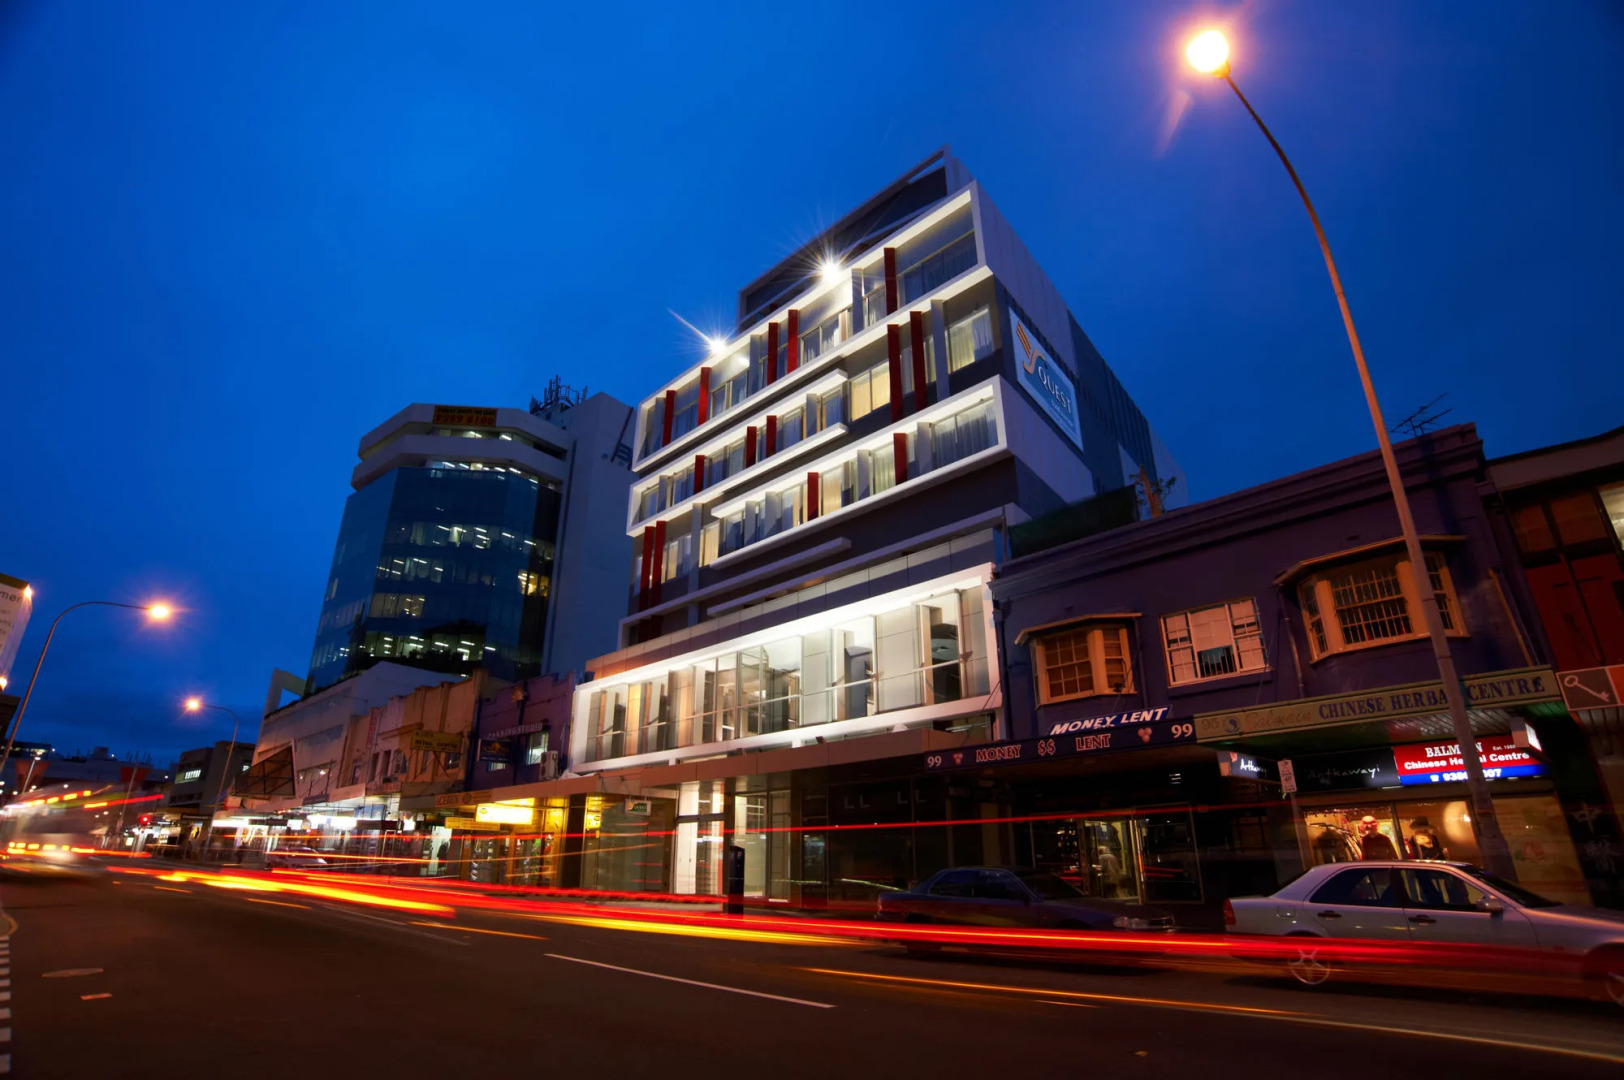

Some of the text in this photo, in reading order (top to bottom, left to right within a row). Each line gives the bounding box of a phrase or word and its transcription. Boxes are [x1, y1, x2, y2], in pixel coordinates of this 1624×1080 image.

[1038, 366, 1071, 414] QUEST
[1318, 696, 1386, 719] CHINESE
[1390, 688, 1449, 711] HERBA
[1467, 677, 1546, 701] CENTRE
[1050, 706, 1168, 736] MONEY LENT
[927, 723, 1194, 768] 99 MONEY $$ LENT 99
[1404, 752, 1531, 770] Chinese Hel Centre
[1425, 742, 1483, 757] BALMN
